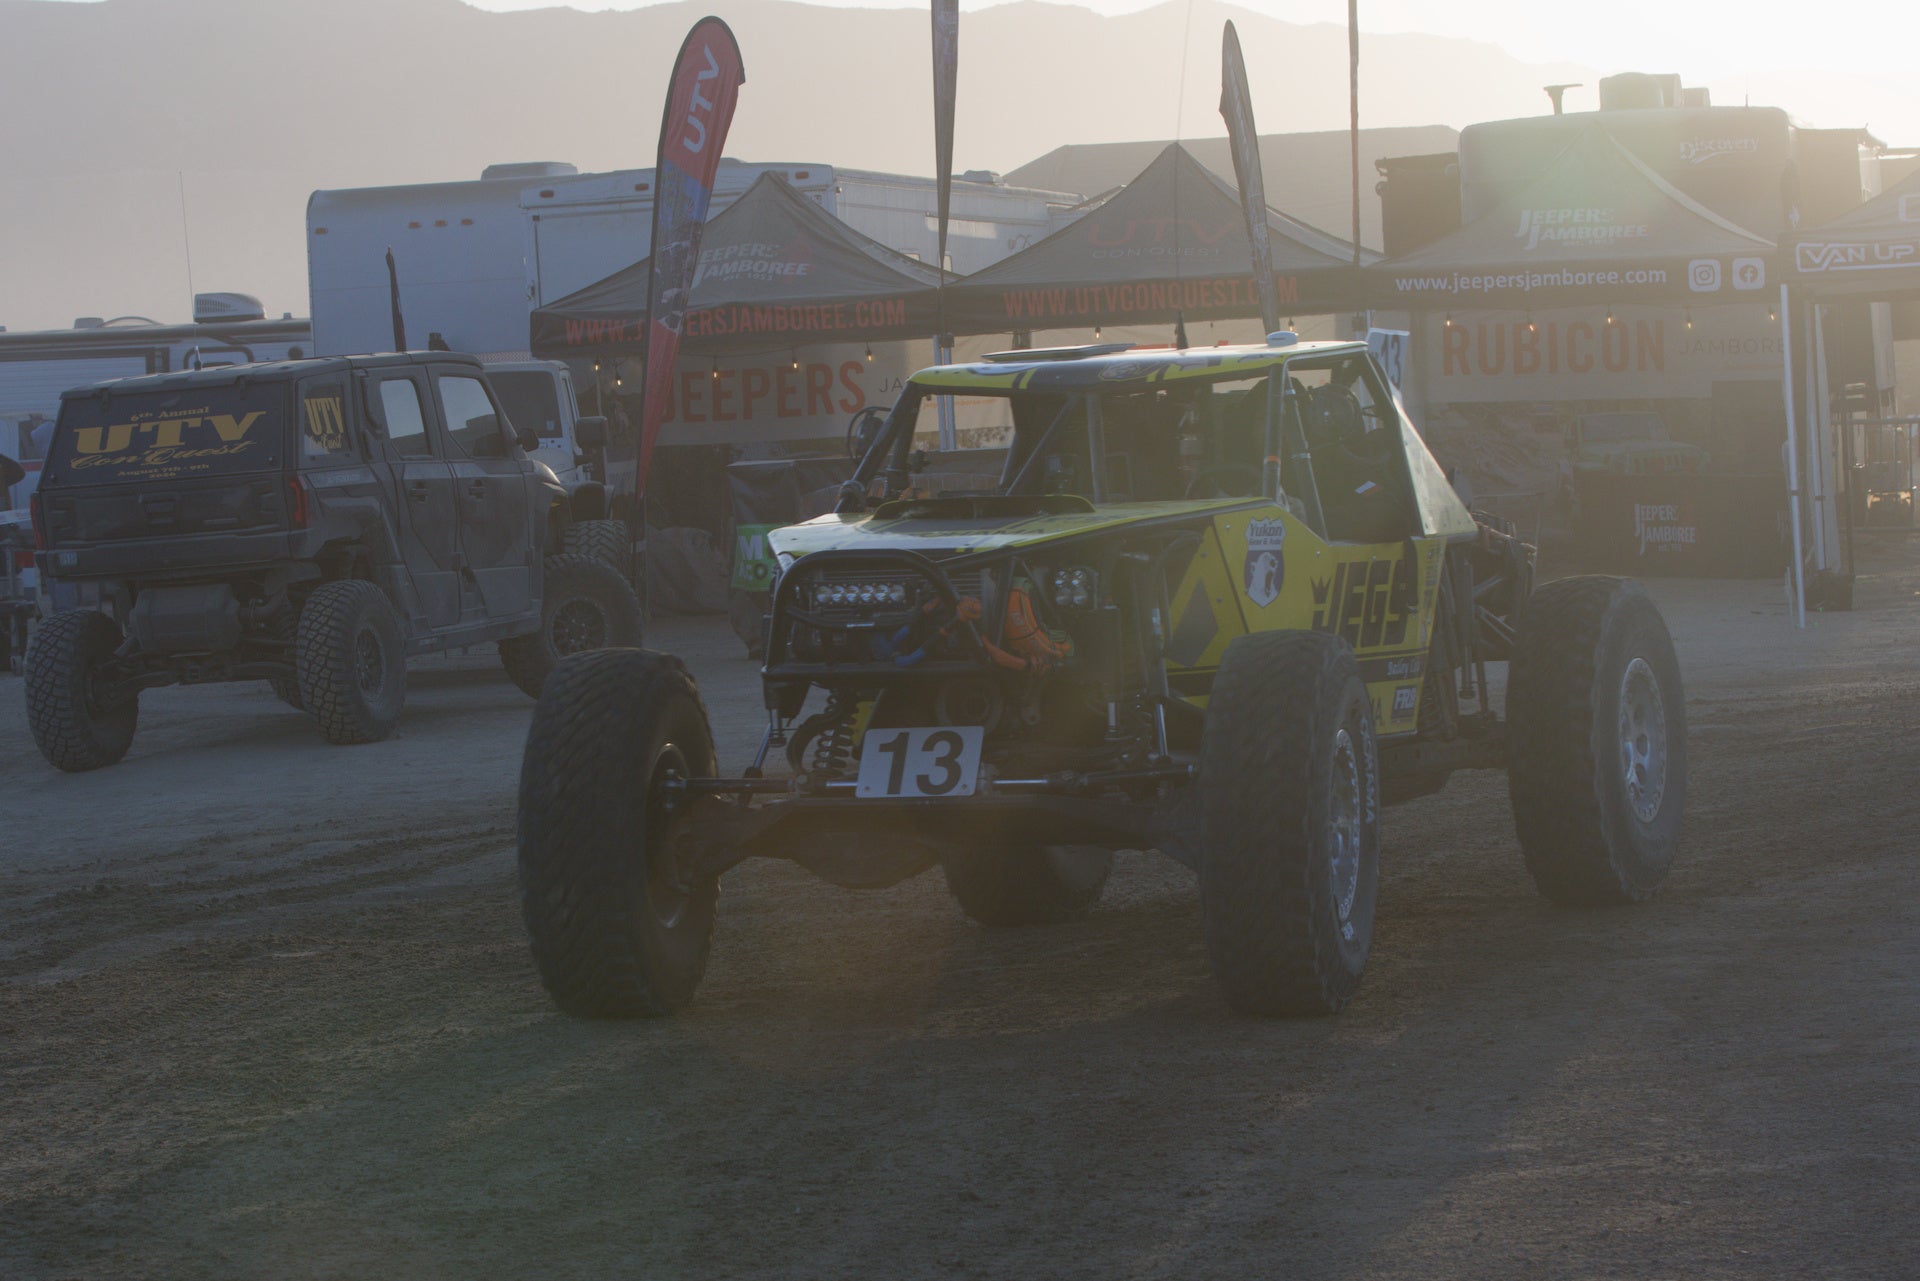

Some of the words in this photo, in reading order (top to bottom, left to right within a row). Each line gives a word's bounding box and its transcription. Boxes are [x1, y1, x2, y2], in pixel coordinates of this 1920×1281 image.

[683, 43, 720, 154] UTV
[1088, 216, 1238, 246] UTV
[1523, 224, 1648, 251] JAMBOREE
[700, 242, 781, 264] EEPERS
[1806, 248, 1866, 265] VAN
[1874, 243, 1915, 261] UP
[691, 260, 811, 291] JAMBOREE
[1395, 268, 1667, 294] www.jeepersjamboree.com
[1004, 277, 1298, 318] WWW.UTVCONQUEST.CM
[565, 299, 906, 345] WWW.JERSJAMBOREE.COM
[1443, 320, 1665, 377] RUBICON
[158, 406, 210, 419] Annual
[303, 397, 345, 435] UTV
[73, 410, 267, 454] UTV
[1249, 524, 1283, 537] Yukon
[1639, 523, 1697, 556] JAMBOREE
[1311, 559, 1411, 649] JEGS
[879, 730, 964, 795] 13
